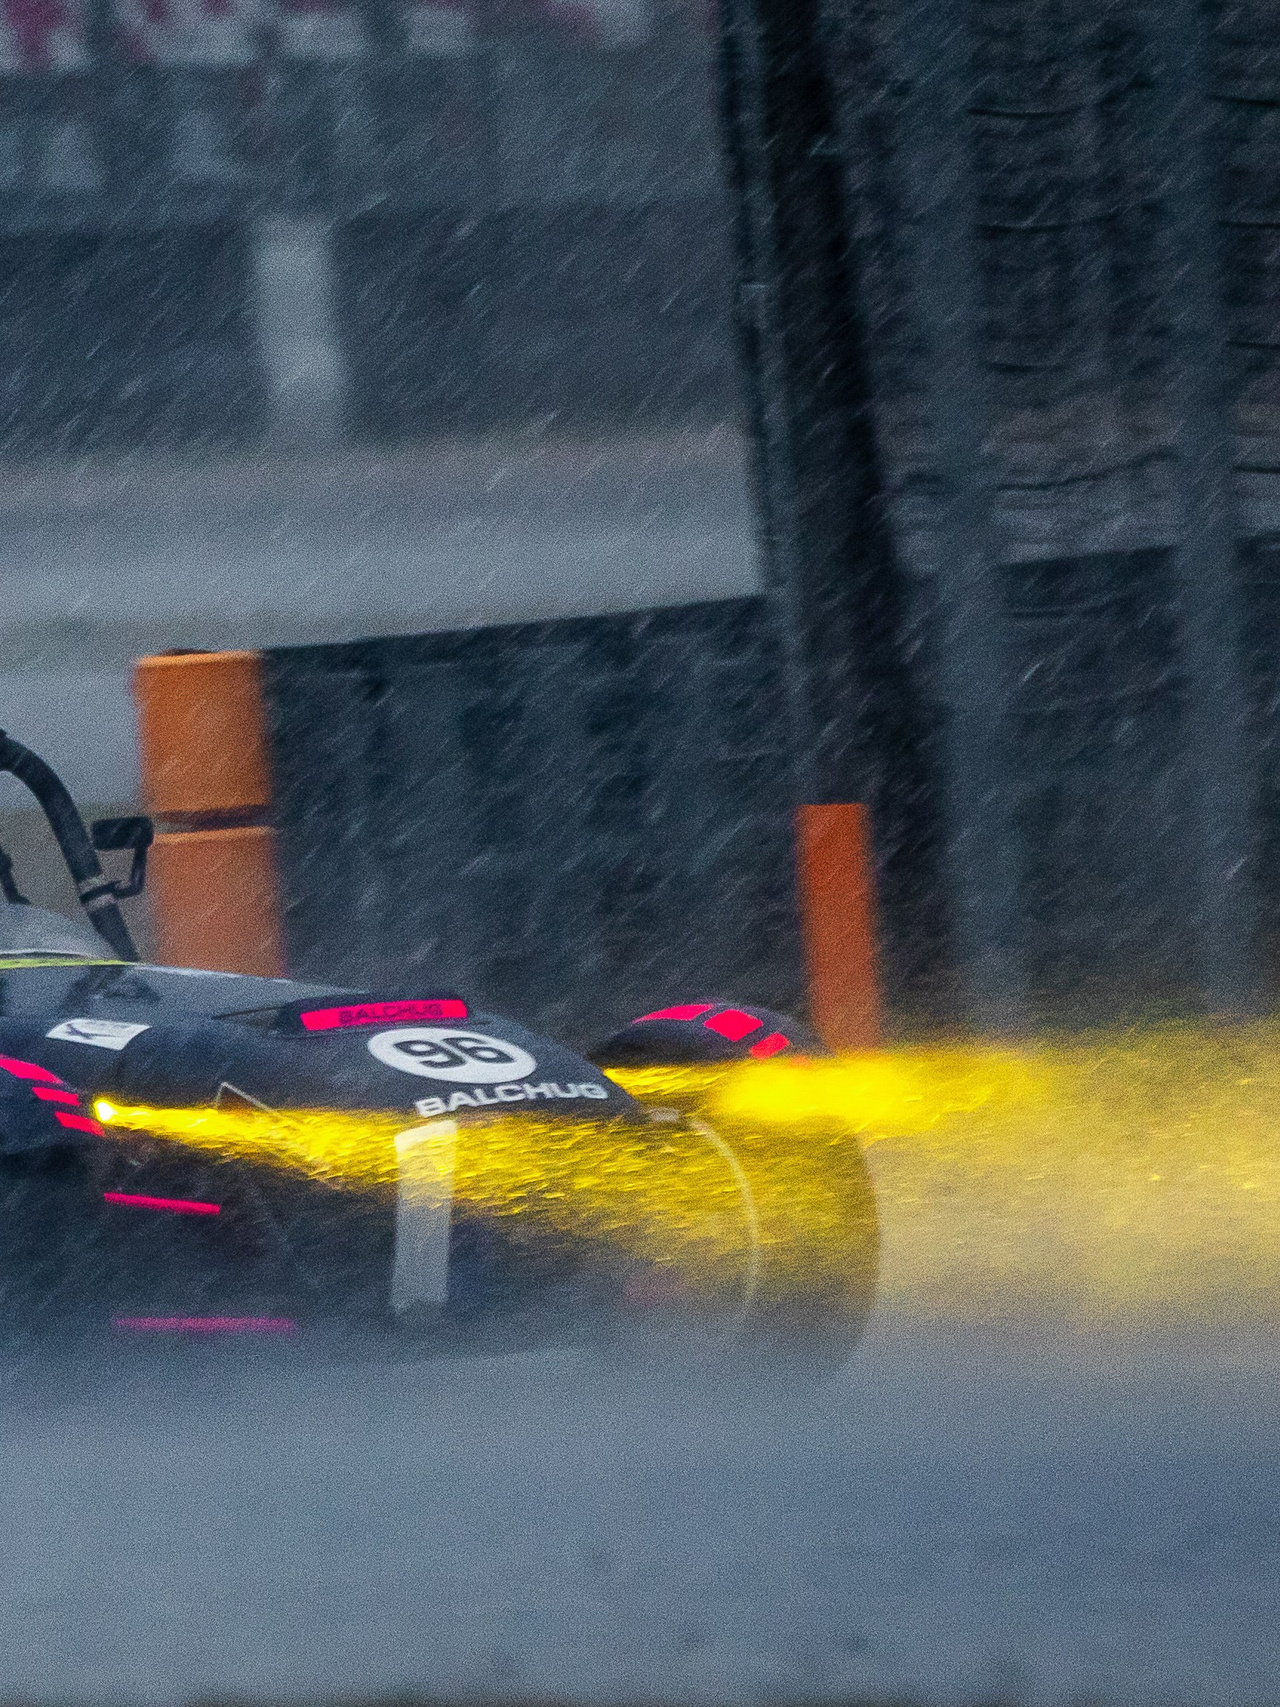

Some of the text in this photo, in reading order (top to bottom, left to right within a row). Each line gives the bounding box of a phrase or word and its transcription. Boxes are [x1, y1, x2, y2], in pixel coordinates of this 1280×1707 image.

[338, 1003, 443, 1024] BALCHUG
[392, 1036, 516, 1070] 96
[415, 1082, 609, 1118] BALCHUG
